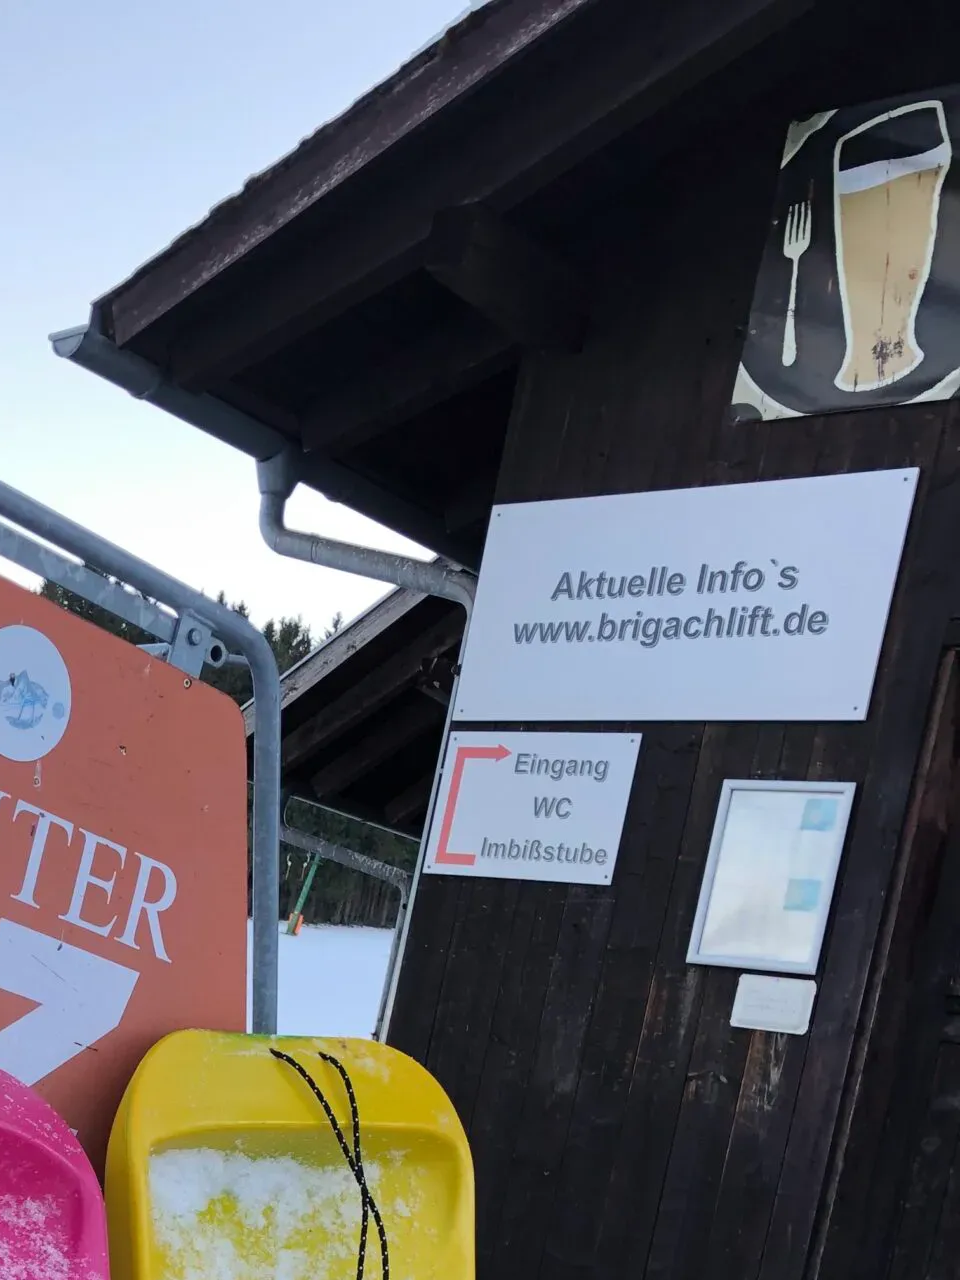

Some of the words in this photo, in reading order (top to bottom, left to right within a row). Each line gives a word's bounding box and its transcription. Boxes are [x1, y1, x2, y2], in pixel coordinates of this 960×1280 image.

[550, 566, 686, 601] Aktuelle
[513, 603, 830, 648] www.brigachlift.de
[514, 752, 610, 782] Eingang
[533, 796, 573, 819] WC
[480, 837, 608, 865] Imbißstube
